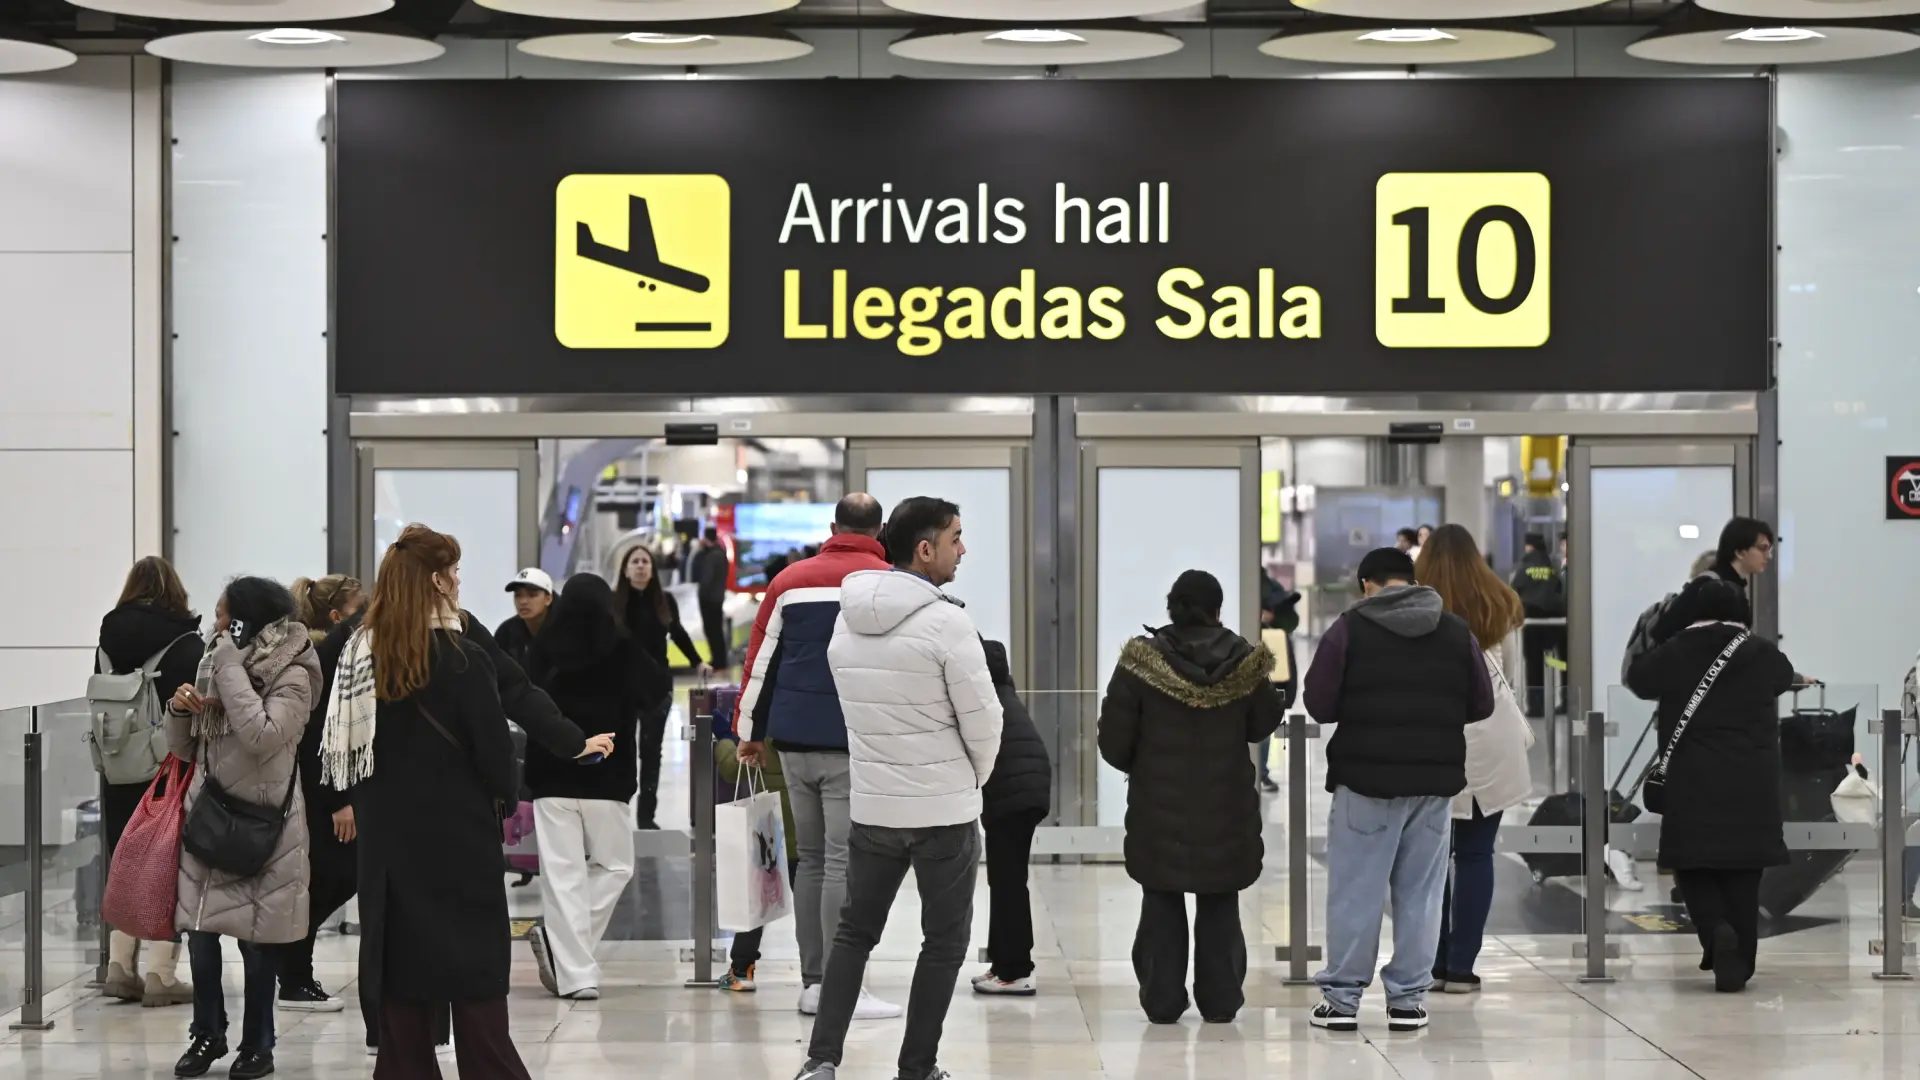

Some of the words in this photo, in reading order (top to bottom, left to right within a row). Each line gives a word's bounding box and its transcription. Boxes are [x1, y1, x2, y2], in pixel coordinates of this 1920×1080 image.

[778, 182, 1027, 244] Arrivals
[1055, 181, 1169, 244] hall
[1392, 204, 1536, 315] 10
[783, 268, 1126, 357] Llegadas
[1155, 267, 1322, 340] Sala
[1705, 658, 1727, 682] LOLA
